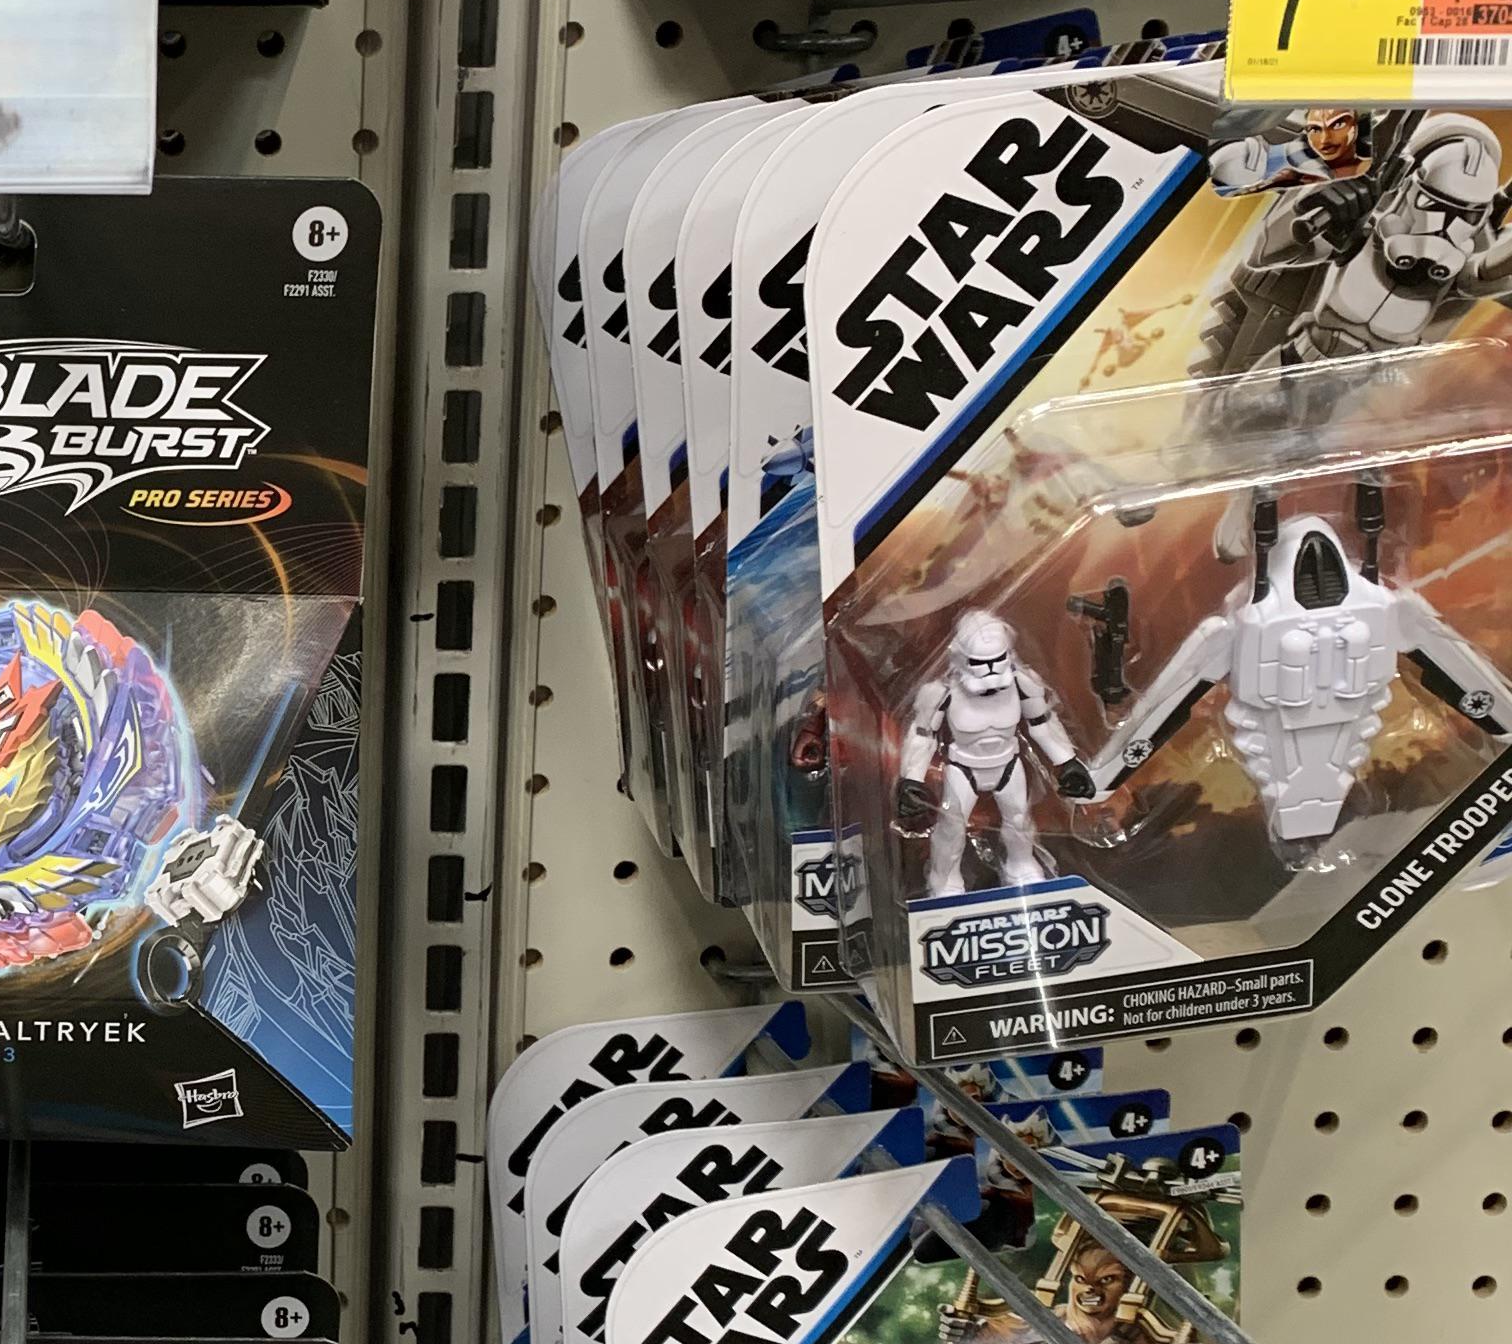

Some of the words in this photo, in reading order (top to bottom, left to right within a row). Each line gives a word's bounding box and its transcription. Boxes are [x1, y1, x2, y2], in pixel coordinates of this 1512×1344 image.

[1058, 35, 1085, 60] 4+
[309, 220, 340, 246] 8+
[833, 115, 1092, 407] STAR
[283, 284, 309, 296] F2291
[854, 133, 1125, 432] WARS
[52, 425, 254, 459] BURST
[129, 488, 182, 509] PRO
[187, 488, 270, 511] SERIES
[1356, 859, 1434, 930] CLONE
[931, 916, 1101, 968] MISSION
[975, 955, 1061, 979] FLEET
[990, 1004, 1115, 1038] WARNING:
[1123, 988, 1175, 1009] CHOKING
[1270, 972, 1304, 994] parts.
[1123, 1012, 1143, 1027] Not
[1146, 1009, 1163, 1024] for
[1165, 1003, 1212, 1022] children
[1215, 997, 1249, 1016] under
[1252, 996, 1259, 1009] 3
[1262, 992, 1296, 1013] years.
[1059, 1060, 1085, 1082] 4+
[1121, 1111, 1149, 1133] 4+
[1190, 1146, 1220, 1169] 4+
[258, 1215, 285, 1238] 8+
[274, 1307, 303, 1329] 8+
